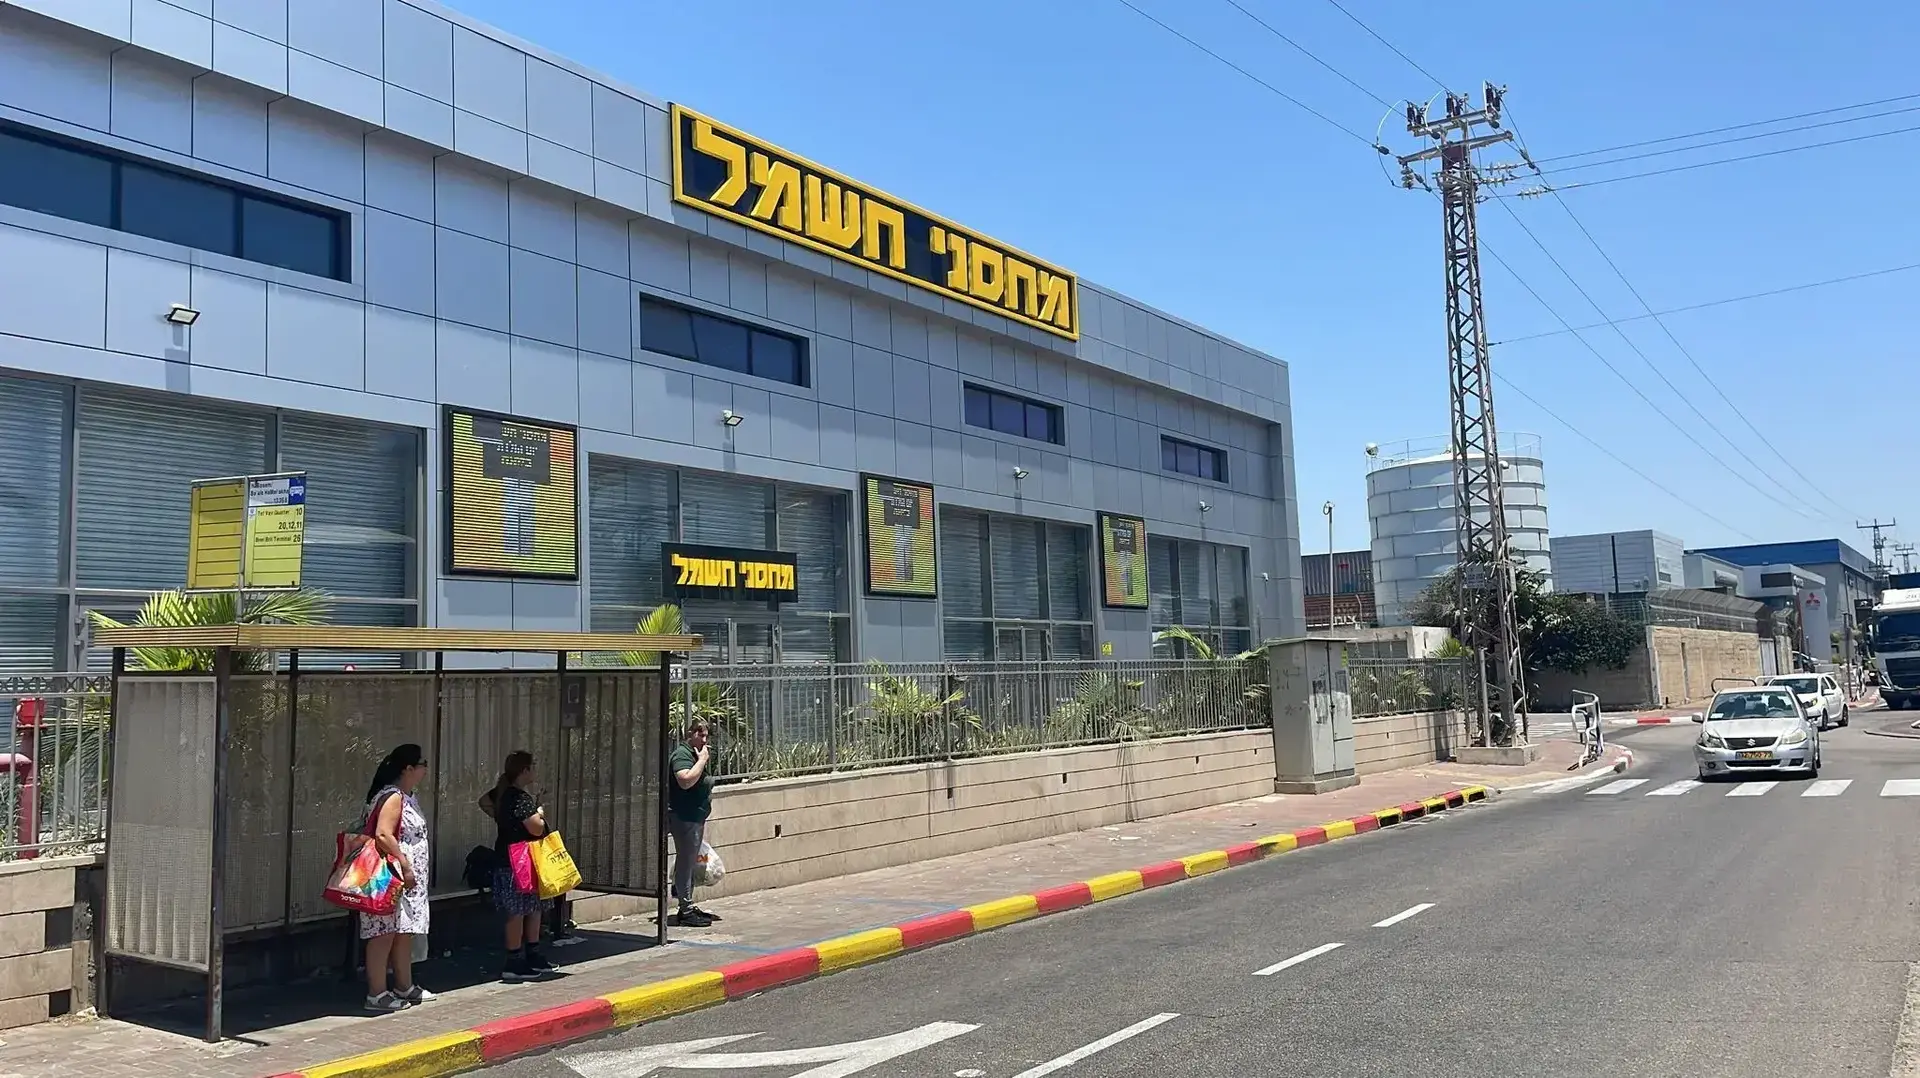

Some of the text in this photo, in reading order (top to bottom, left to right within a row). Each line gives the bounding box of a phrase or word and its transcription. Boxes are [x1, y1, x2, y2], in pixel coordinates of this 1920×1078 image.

[692, 119, 1069, 329] מחסני חשמל
[295, 508, 303, 516] 10
[293, 535, 301, 543] 26
[671, 553, 795, 590] מחסני חשמל
